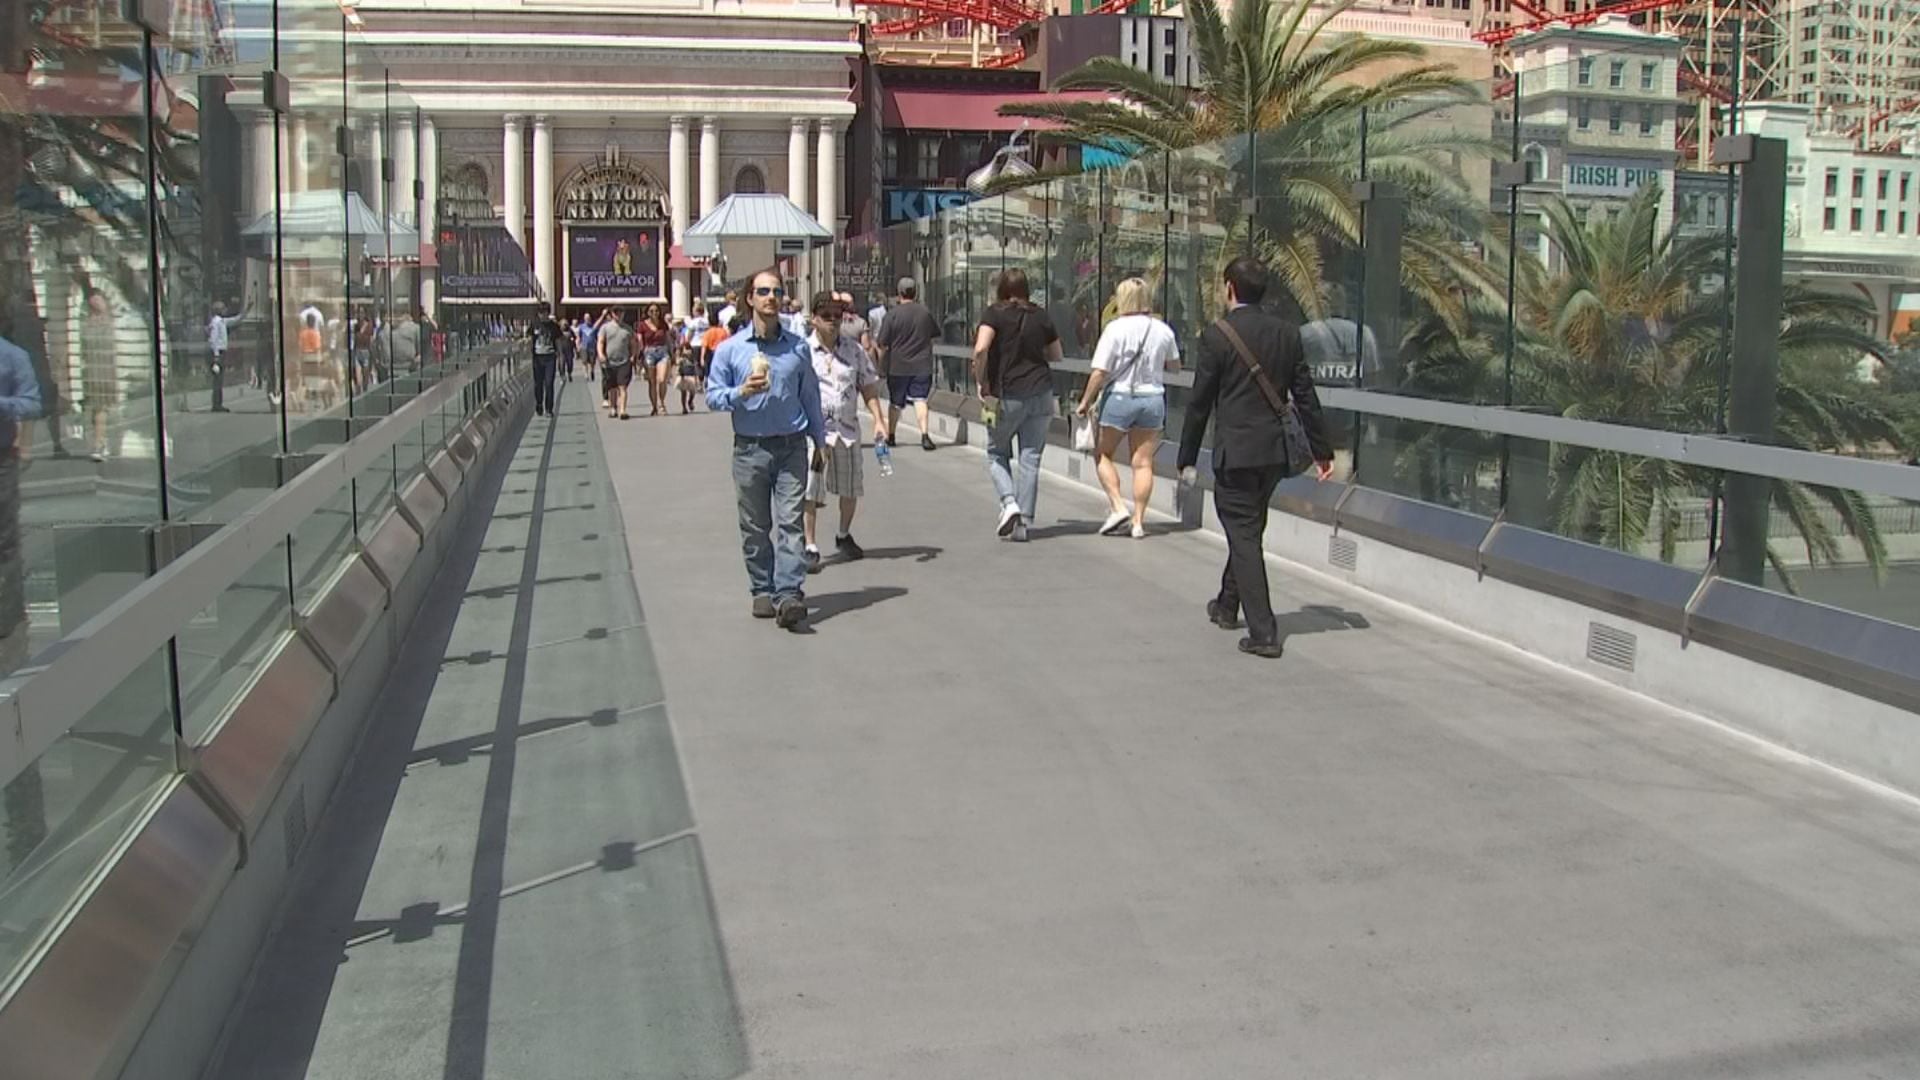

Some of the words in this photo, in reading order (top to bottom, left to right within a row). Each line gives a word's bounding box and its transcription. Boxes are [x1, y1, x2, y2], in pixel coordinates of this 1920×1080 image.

[1569, 165, 1618, 186] IRISH
[1624, 169, 1658, 188] PUB
[567, 185, 608, 200] NEW
[612, 185, 660, 200] YORK
[567, 203, 608, 219] NEW
[612, 203, 660, 219] YORK
[574, 275, 615, 287] TERRY
[617, 275, 655, 287] FATOR
